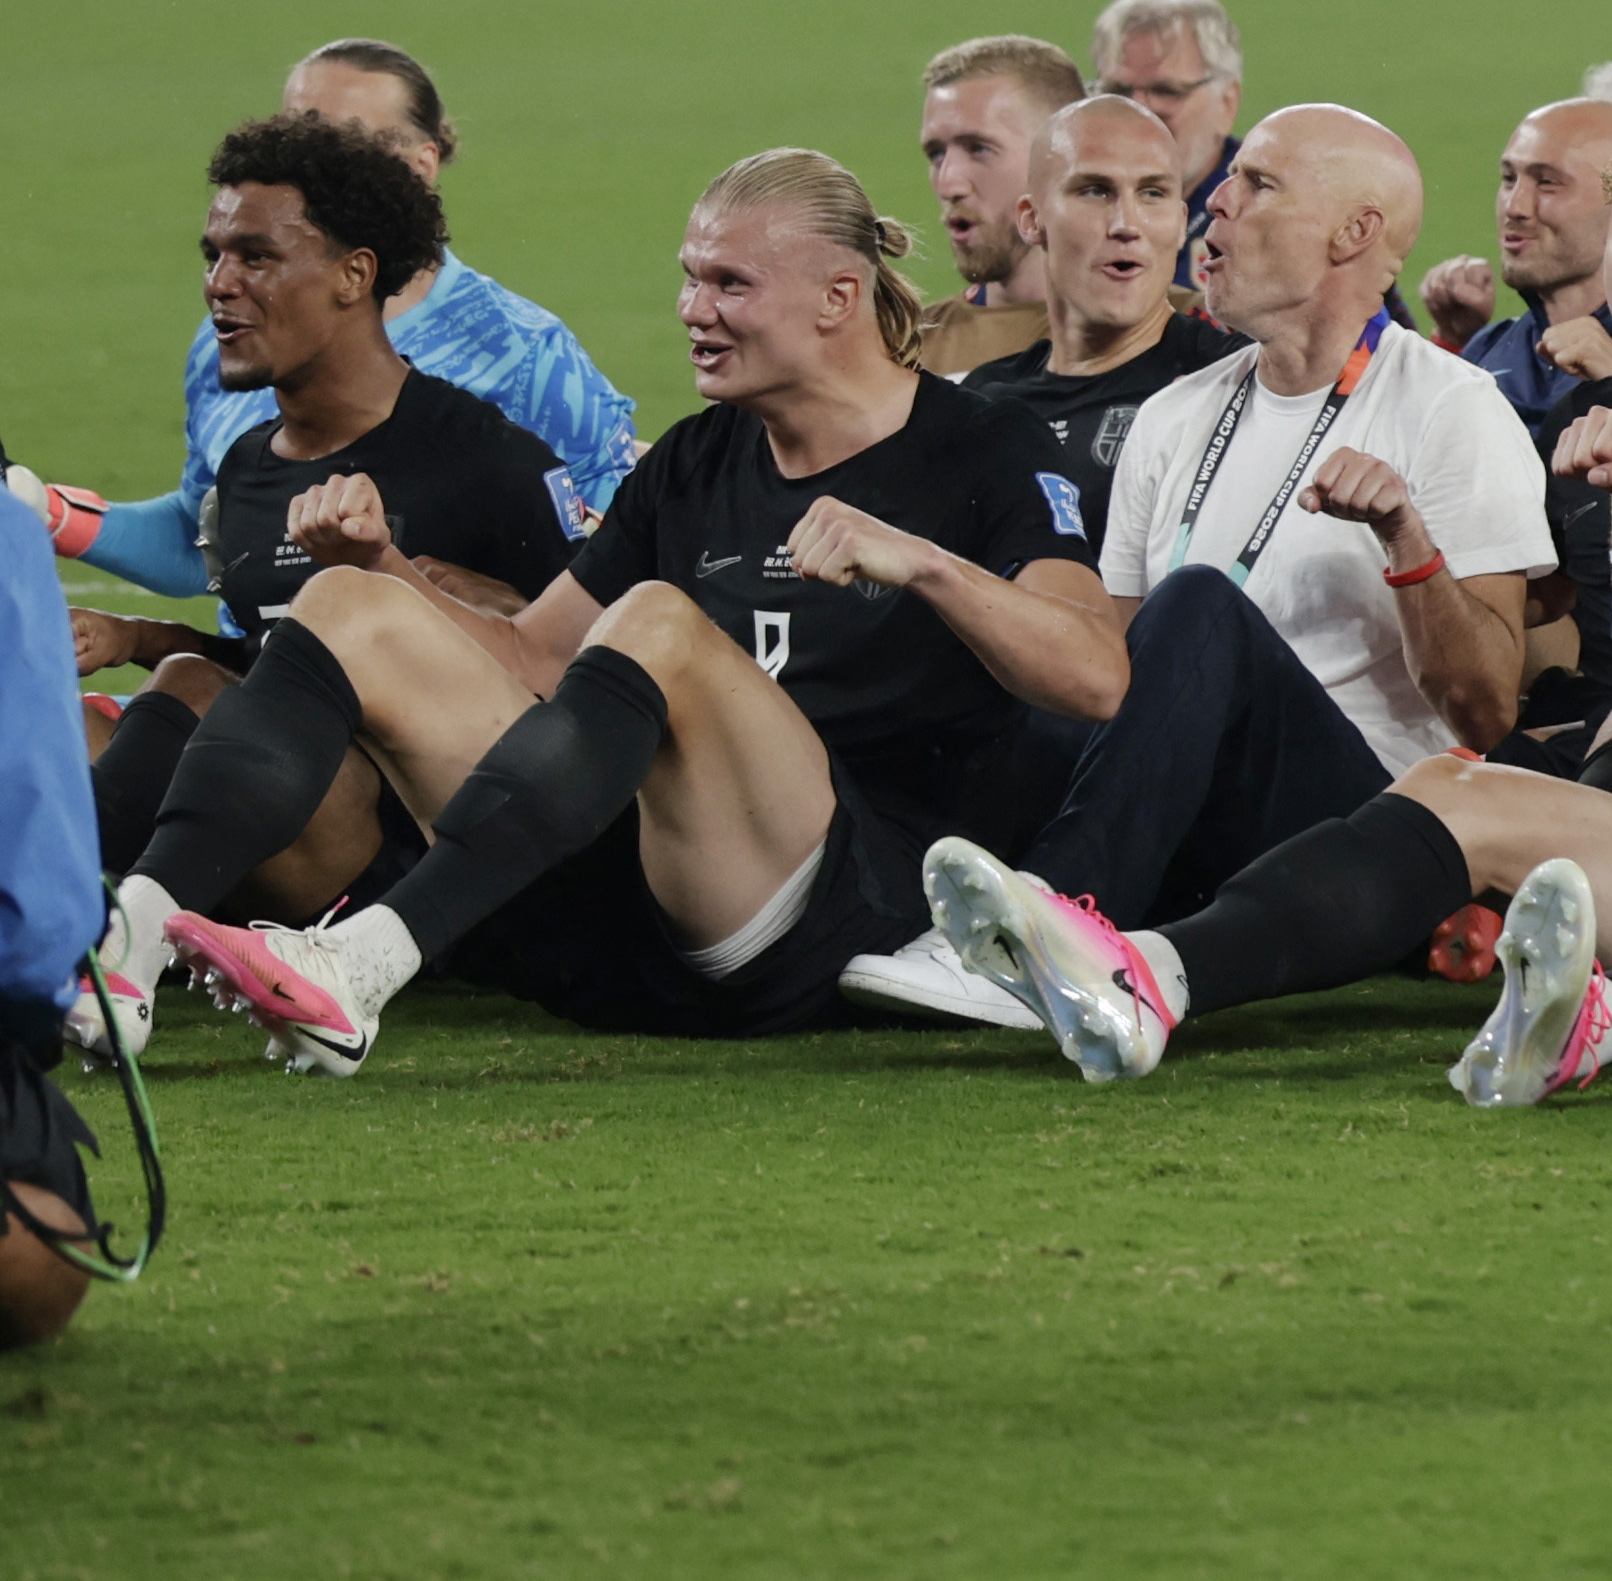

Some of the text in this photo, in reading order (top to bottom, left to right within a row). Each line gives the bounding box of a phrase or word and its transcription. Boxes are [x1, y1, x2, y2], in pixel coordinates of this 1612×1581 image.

[1187, 478, 1207, 511] FIFA
[1198, 436, 1226, 482] WORLD
[1218, 411, 1236, 437] CUP
[1249, 404, 1337, 552] FIFA WORLD CUP 2026
